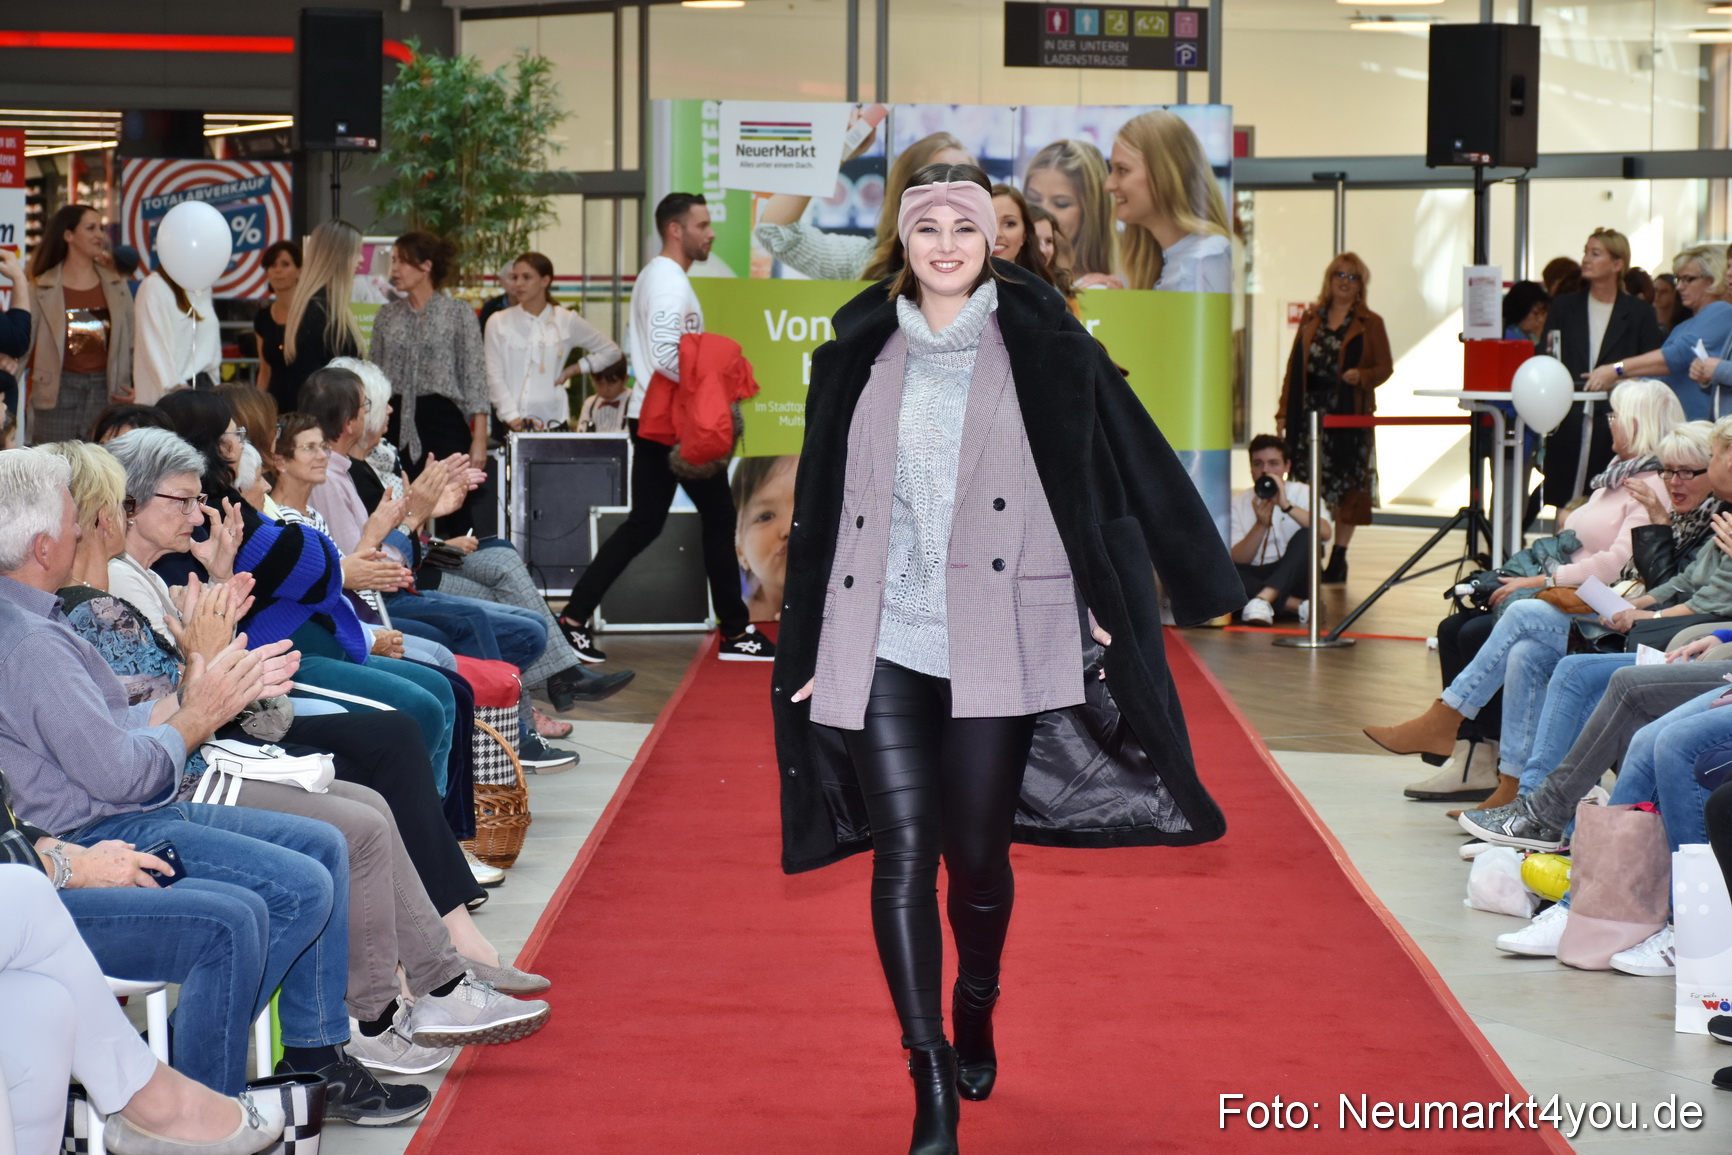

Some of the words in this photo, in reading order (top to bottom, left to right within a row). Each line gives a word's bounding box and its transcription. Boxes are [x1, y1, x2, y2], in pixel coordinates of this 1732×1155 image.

[1080, 40, 1129, 52] UNTEREN
[1044, 53, 1129, 66] LADENSTRASSE
[736, 143, 816, 158] NeuerMarkt
[764, 309, 831, 342] Von
[779, 415, 806, 427] Multi
